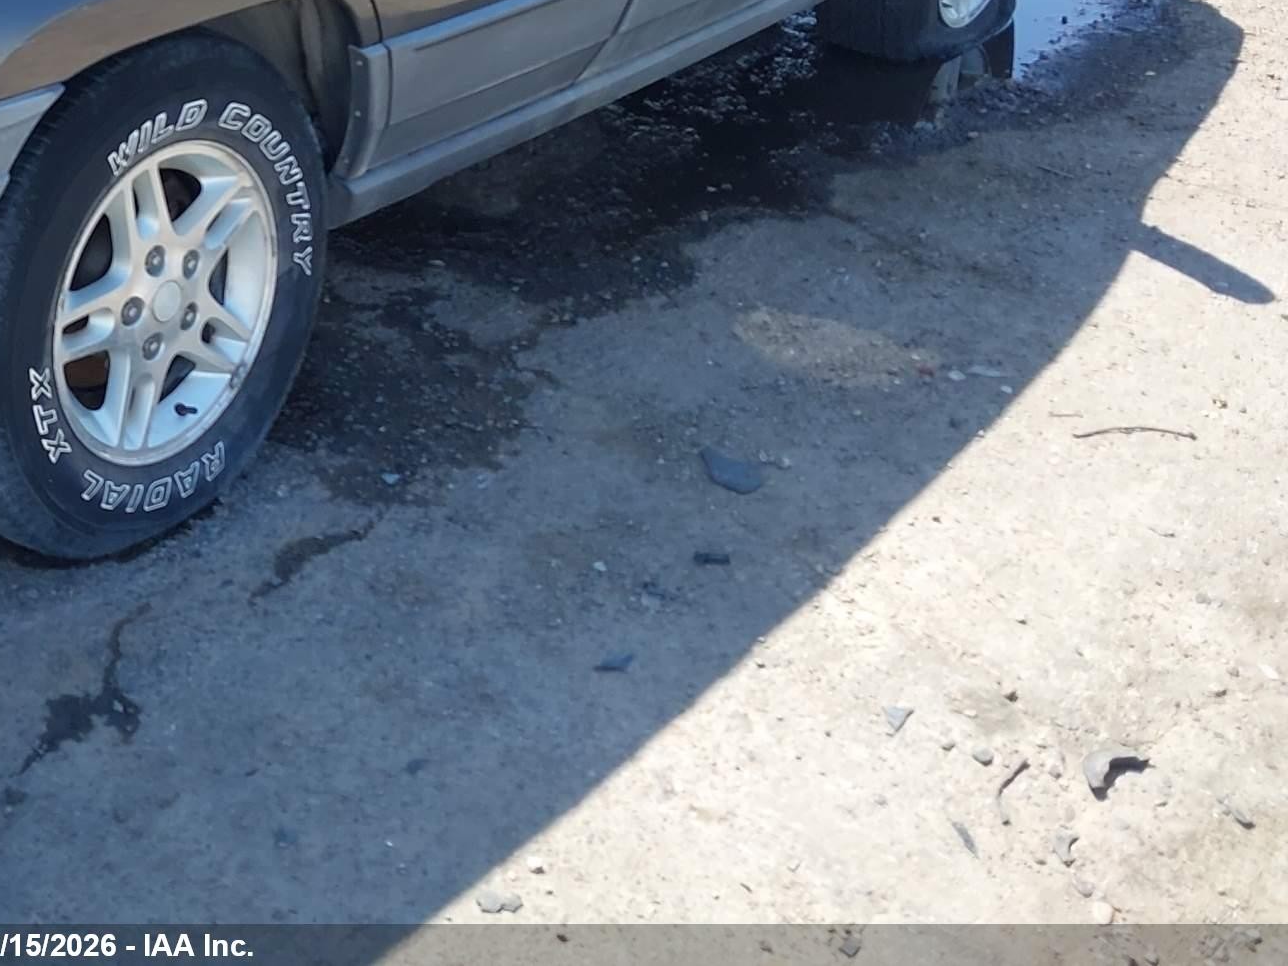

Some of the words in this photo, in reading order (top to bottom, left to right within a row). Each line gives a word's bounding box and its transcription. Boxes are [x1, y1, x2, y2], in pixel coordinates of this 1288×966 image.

[107, 98, 208, 177] WILD
[218, 101, 313, 276] COUNTRY
[28, 367, 73, 464] XTX
[80, 440, 226, 514] RADIAL
